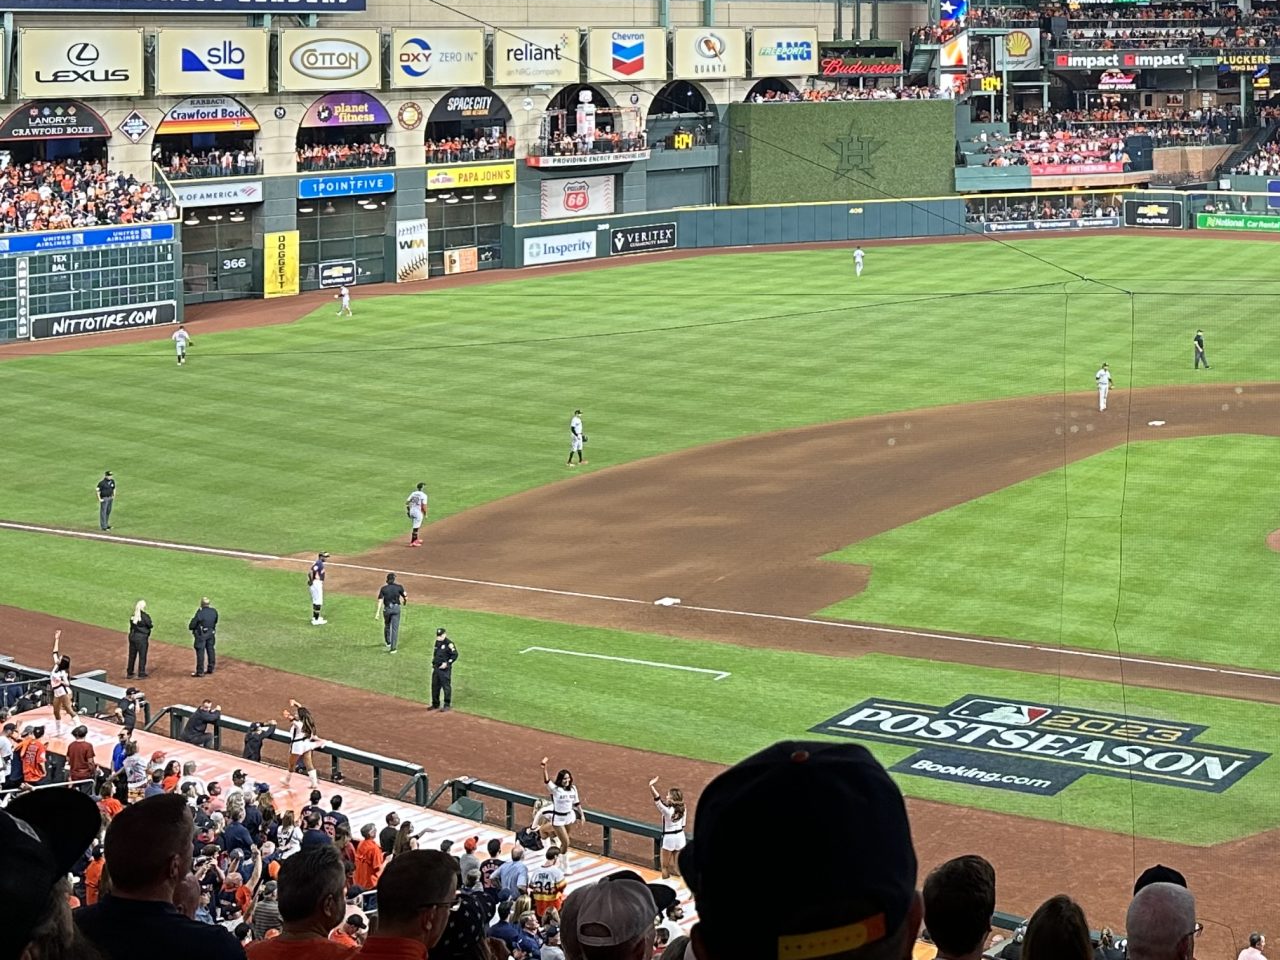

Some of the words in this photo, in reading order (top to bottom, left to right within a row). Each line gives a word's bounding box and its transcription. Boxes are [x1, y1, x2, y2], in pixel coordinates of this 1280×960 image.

[611, 31, 645, 41] Chevron
[207, 40, 245, 64] slb
[399, 52, 432, 63] OXY
[439, 51, 462, 63] ZERO
[506, 42, 562, 61] reliant
[776, 41, 812, 61] LNG
[300, 48, 359, 70] COTTON
[1068, 53, 1119, 69] impact
[1134, 52, 1185, 67] impact
[1216, 55, 1271, 64] PLUCKERS
[694, 64, 727, 74] QUANTA
[820, 57, 903, 76] Budweiser
[35, 69, 129, 83] LEXUS
[334, 104, 368, 116] planet
[447, 97, 474, 111] SPACE
[474, 96, 492, 110] CITY
[28, 116, 77, 125] LANDRY'S
[170, 109, 218, 120] Crawford
[221, 107, 246, 118] Bock
[338, 111, 375, 123] fitness
[12, 127, 63, 136] CRAWFORD
[66, 126, 94, 134] BOXES
[552, 155, 587, 164] PROVIDING
[458, 172, 479, 183] PAPA
[480, 169, 511, 182] JOHN'S
[312, 178, 384, 193] 1POINTFIVE
[199, 191, 239, 202] AMERICA
[567, 193, 585, 207] 66
[627, 229, 672, 243] VERITEX
[543, 239, 592, 256] Insperity
[52, 254, 67, 262] TEX
[223, 259, 247, 270] 366
[278, 235, 286, 289] DOGGETT
[52, 263, 66, 271] BAL
[52, 307, 157, 336] NITTOTIRE.COM
[1040, 712, 1184, 742] 2023
[838, 706, 1244, 781] POSTSEASON
[910, 758, 1052, 790] Booking.com
